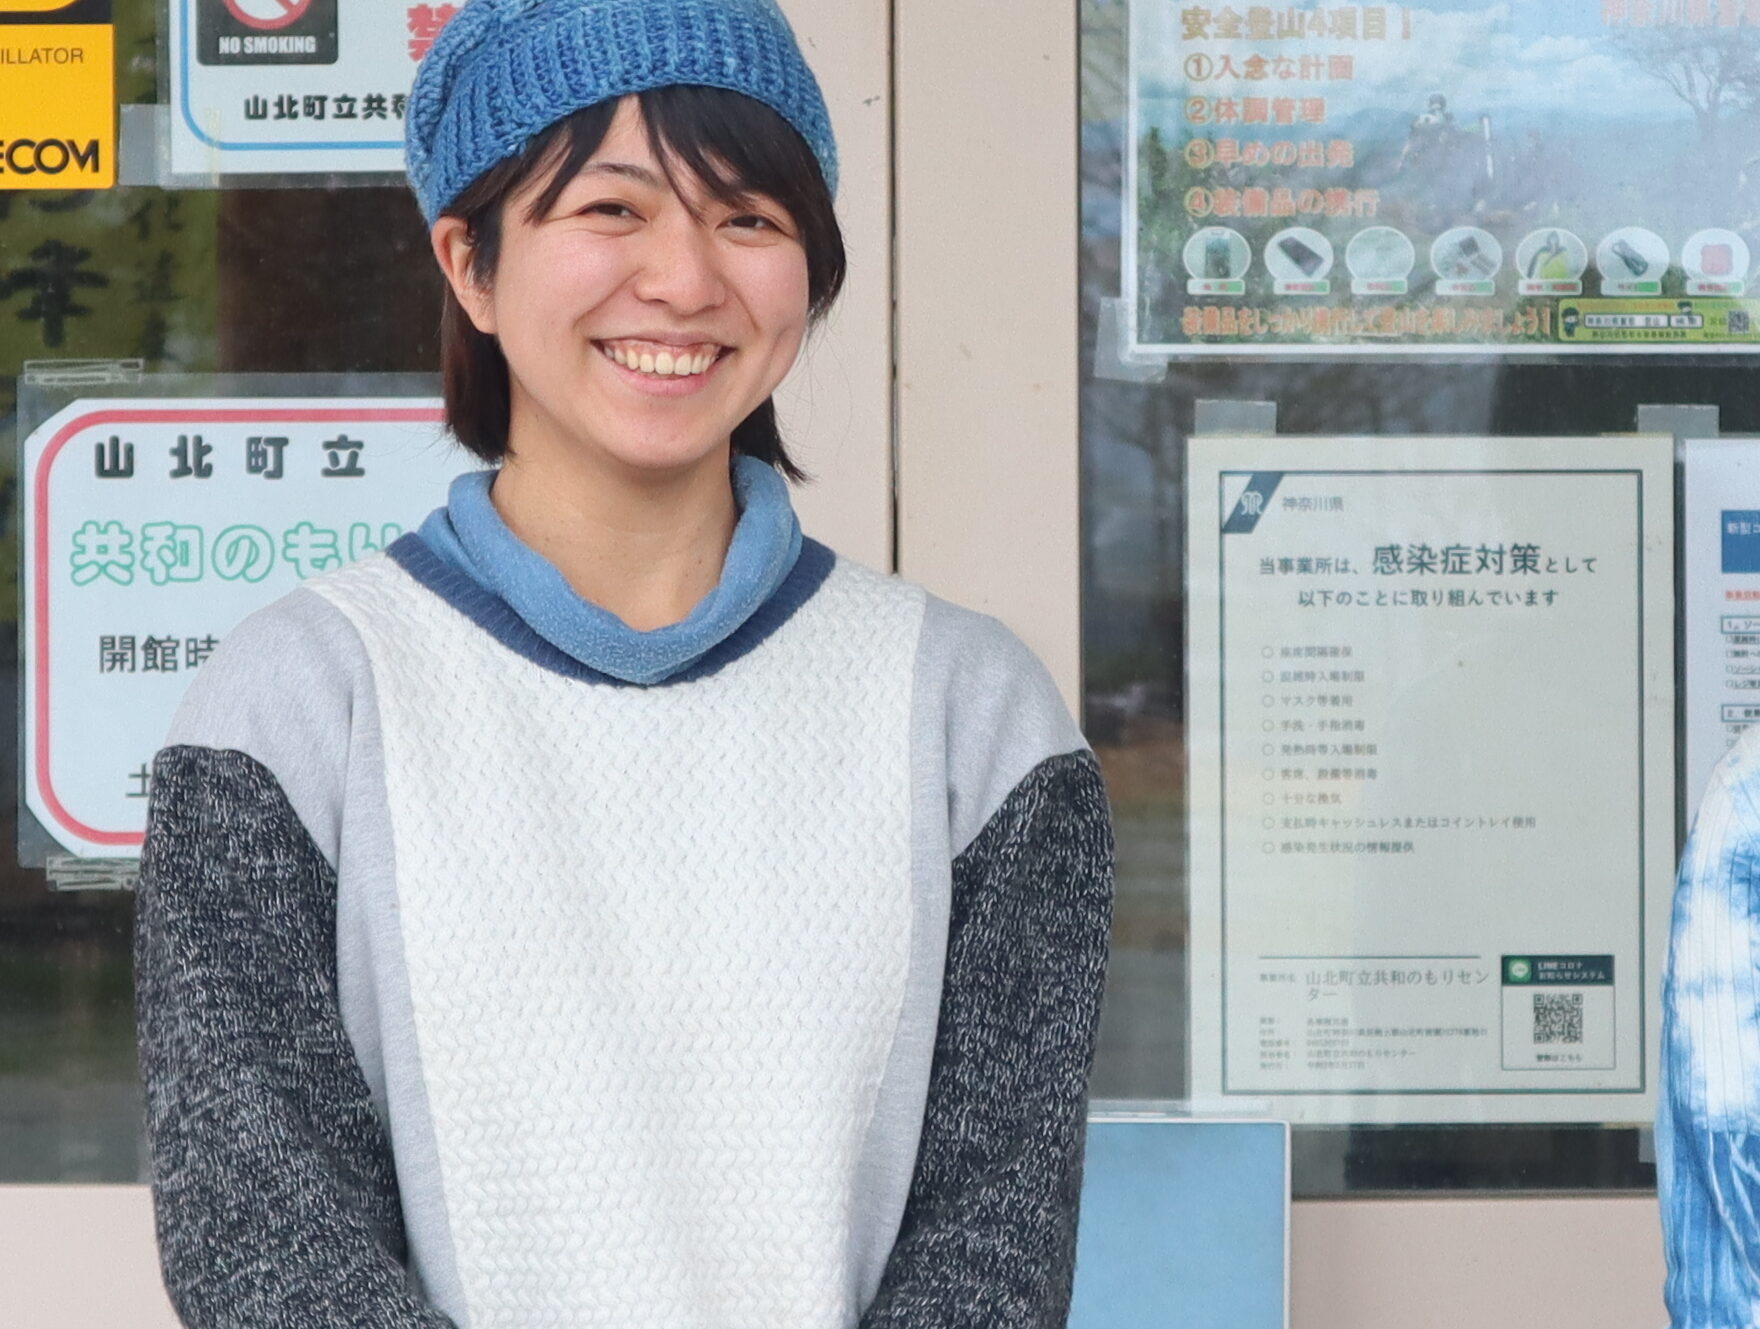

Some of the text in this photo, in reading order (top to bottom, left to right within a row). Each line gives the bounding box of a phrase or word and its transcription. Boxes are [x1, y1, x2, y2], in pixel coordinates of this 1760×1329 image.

[219, 36, 317, 54] NO SMOKING
[94, 434, 365, 479] 山北町立
